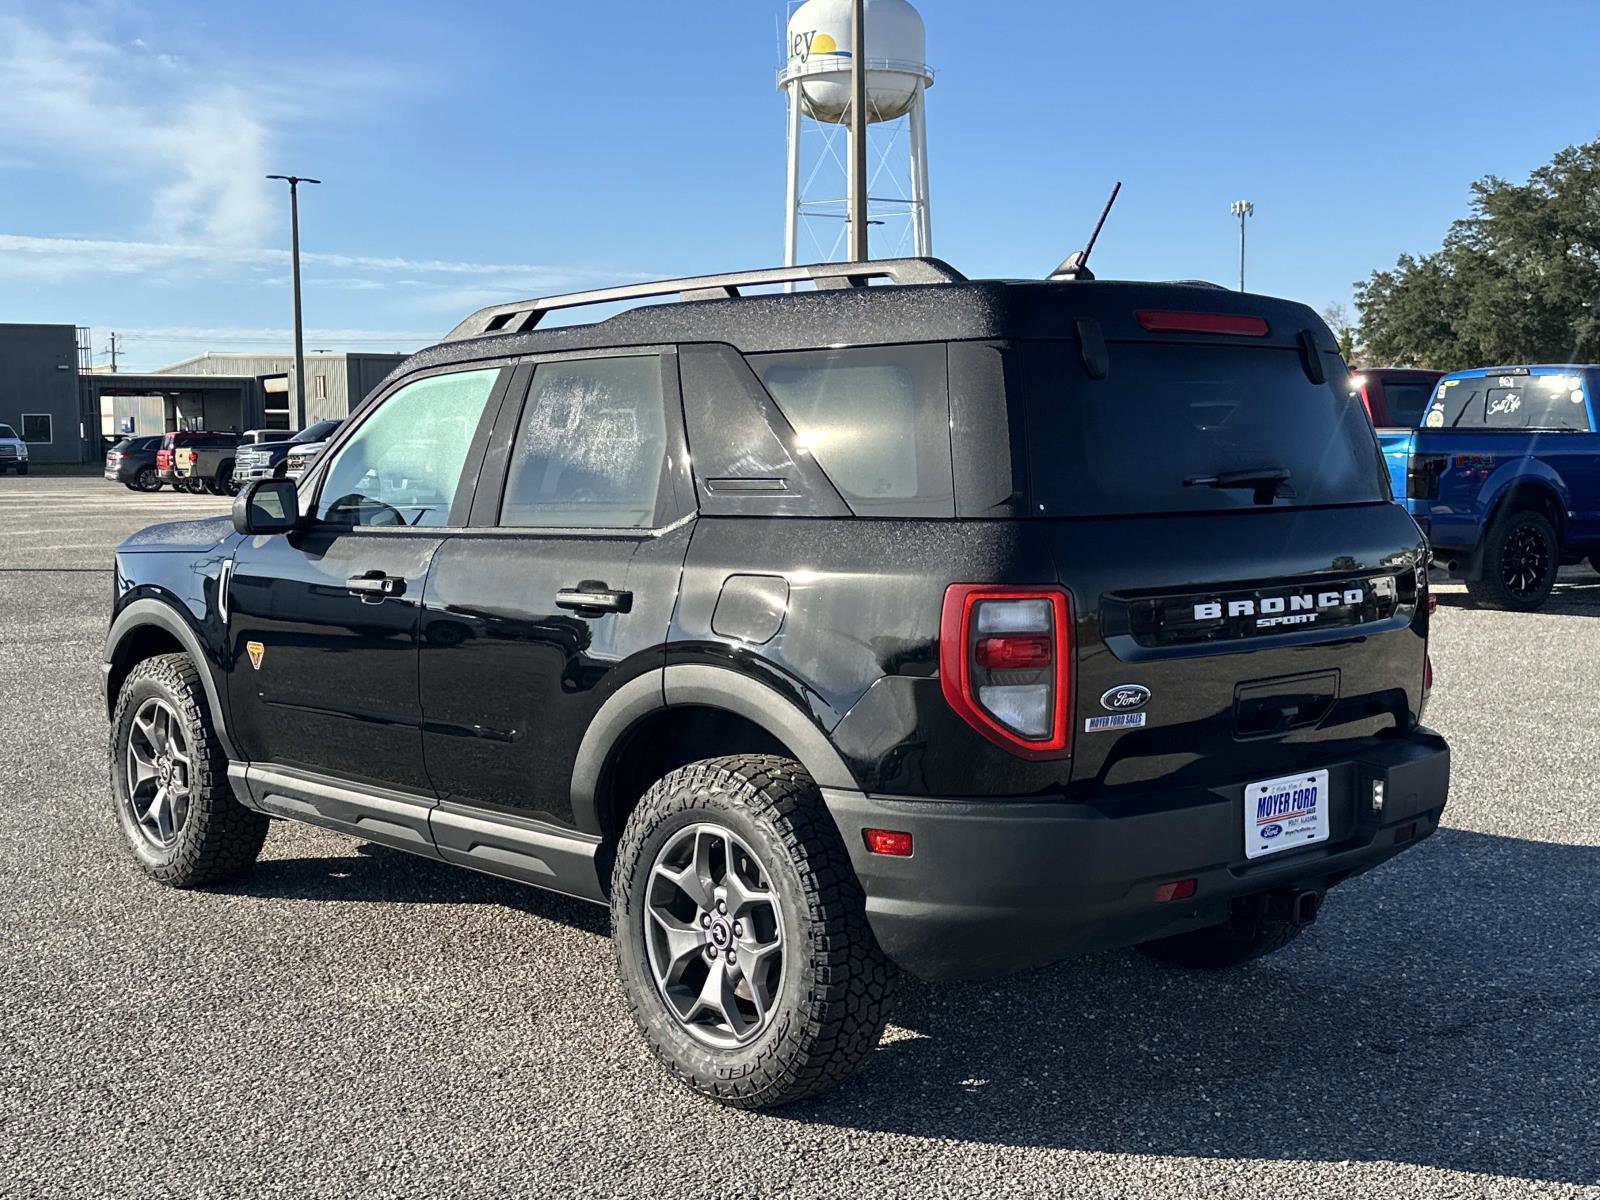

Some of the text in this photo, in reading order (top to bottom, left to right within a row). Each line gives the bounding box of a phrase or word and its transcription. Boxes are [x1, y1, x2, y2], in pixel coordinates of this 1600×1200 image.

[787, 30, 817, 64] ley
[1194, 588, 1363, 620] BRONCO
[1256, 613, 1319, 628] SPORT
[1114, 691, 1141, 707] Ford
[1089, 713, 1143, 728] MOYER FORD SALES
[1257, 792, 1290, 818] MOYER
[1292, 787, 1317, 810] FORD
[1263, 826, 1281, 837] Ford
[716, 1010, 791, 1080] FALKEN
